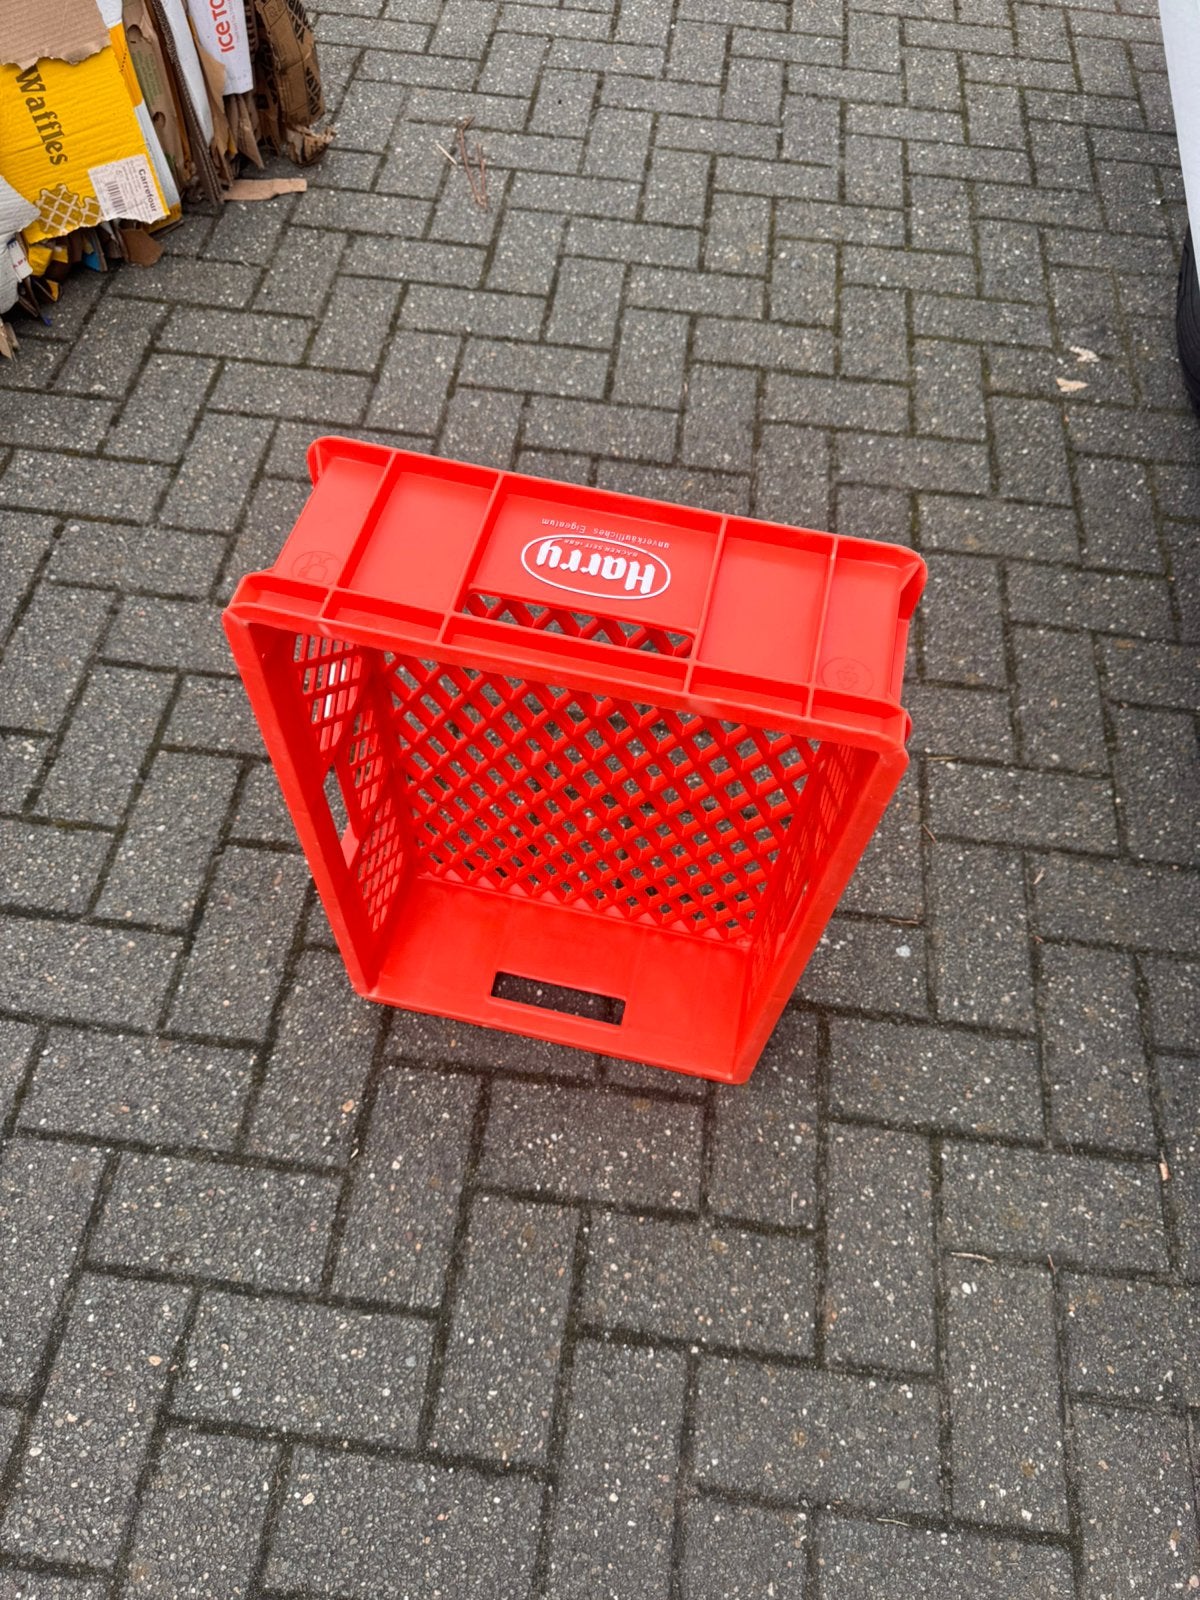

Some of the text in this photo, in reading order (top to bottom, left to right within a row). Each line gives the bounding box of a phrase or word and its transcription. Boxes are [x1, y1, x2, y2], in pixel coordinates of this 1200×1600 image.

[15, 63, 68, 166] Waffles
[138, 168, 158, 212] Carrefour
[541, 518, 586, 533] Eigentum
[536, 539, 655, 594] Harry
